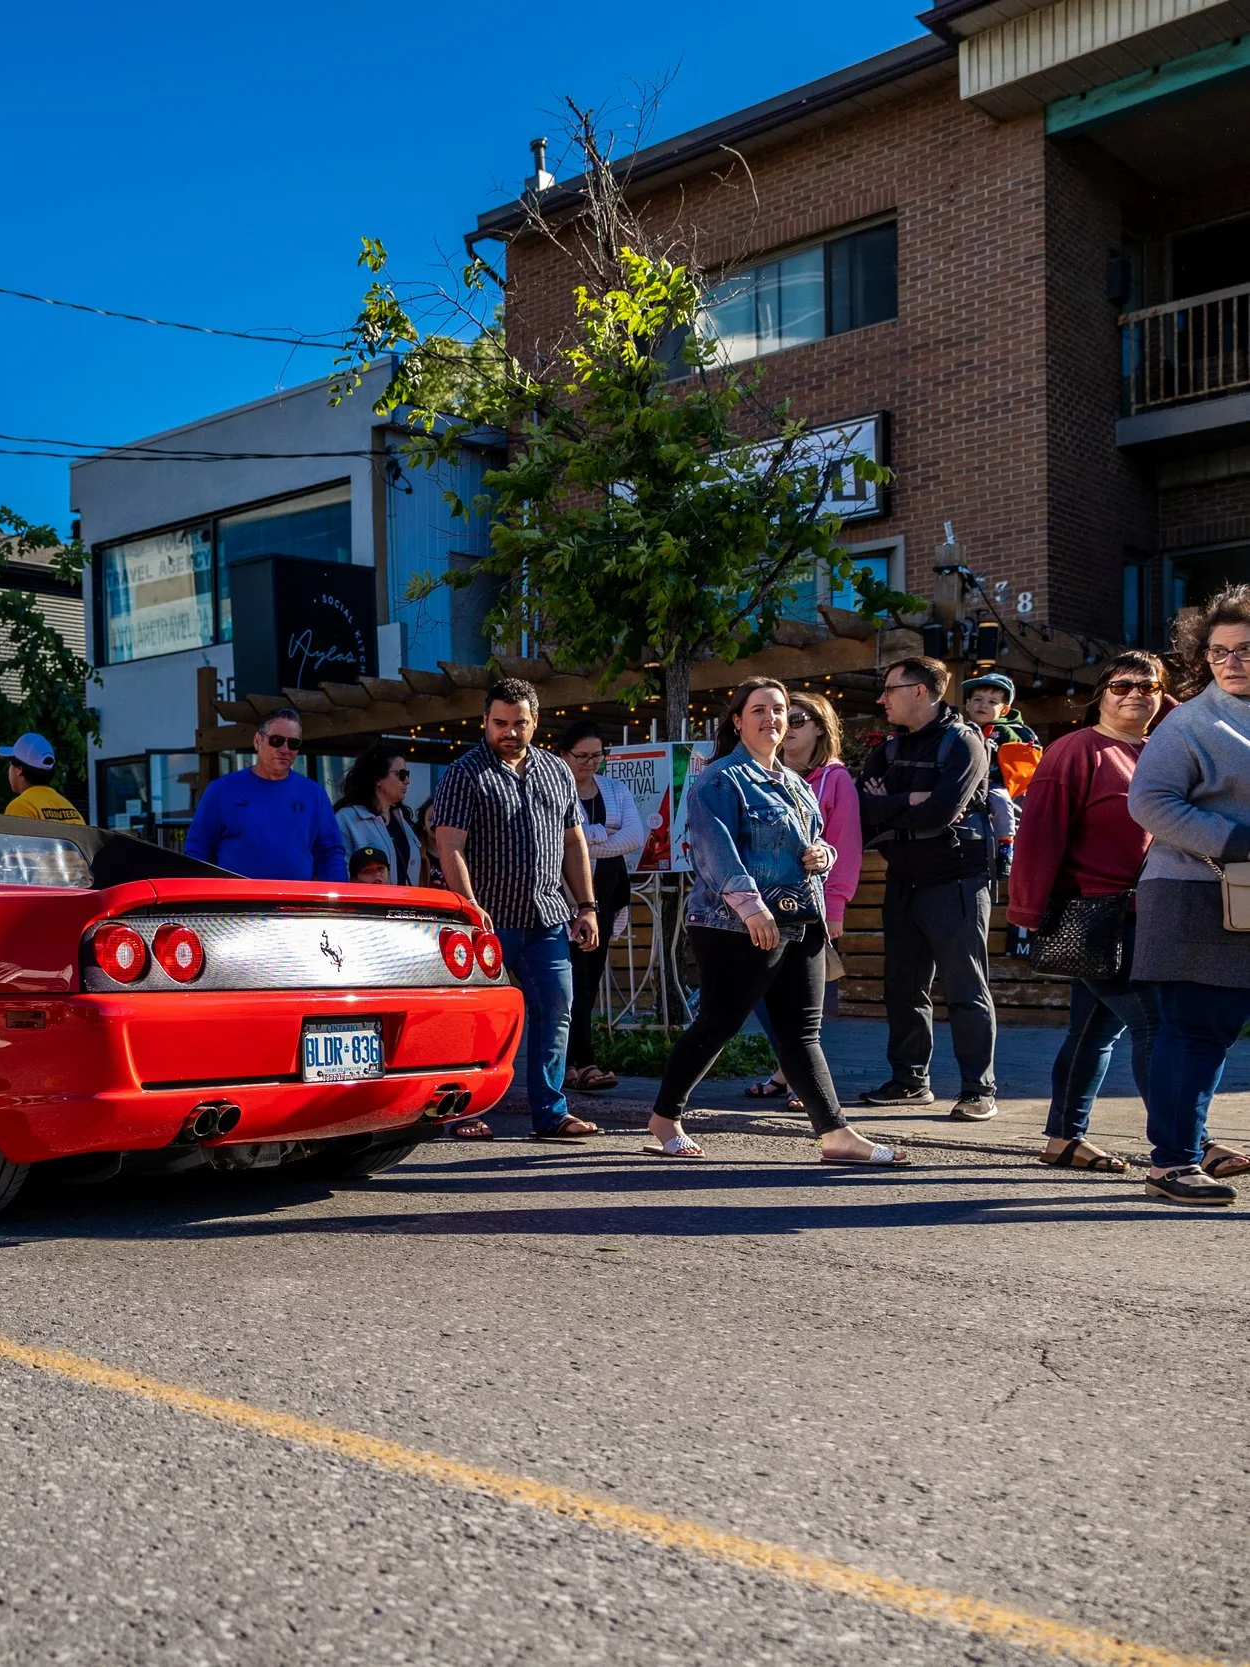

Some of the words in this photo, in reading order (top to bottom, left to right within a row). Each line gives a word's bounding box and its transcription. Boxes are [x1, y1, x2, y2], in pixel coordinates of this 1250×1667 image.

[158, 549, 211, 577] AGENCY
[321, 594, 352, 624] SOCIAL
[605, 760, 654, 779] FERRARI
[619, 777, 661, 795] TIVAL
[326, 1024, 358, 1034] ONTARIO
[305, 1036, 344, 1067] BLDR
[351, 1034, 380, 1065] 836
